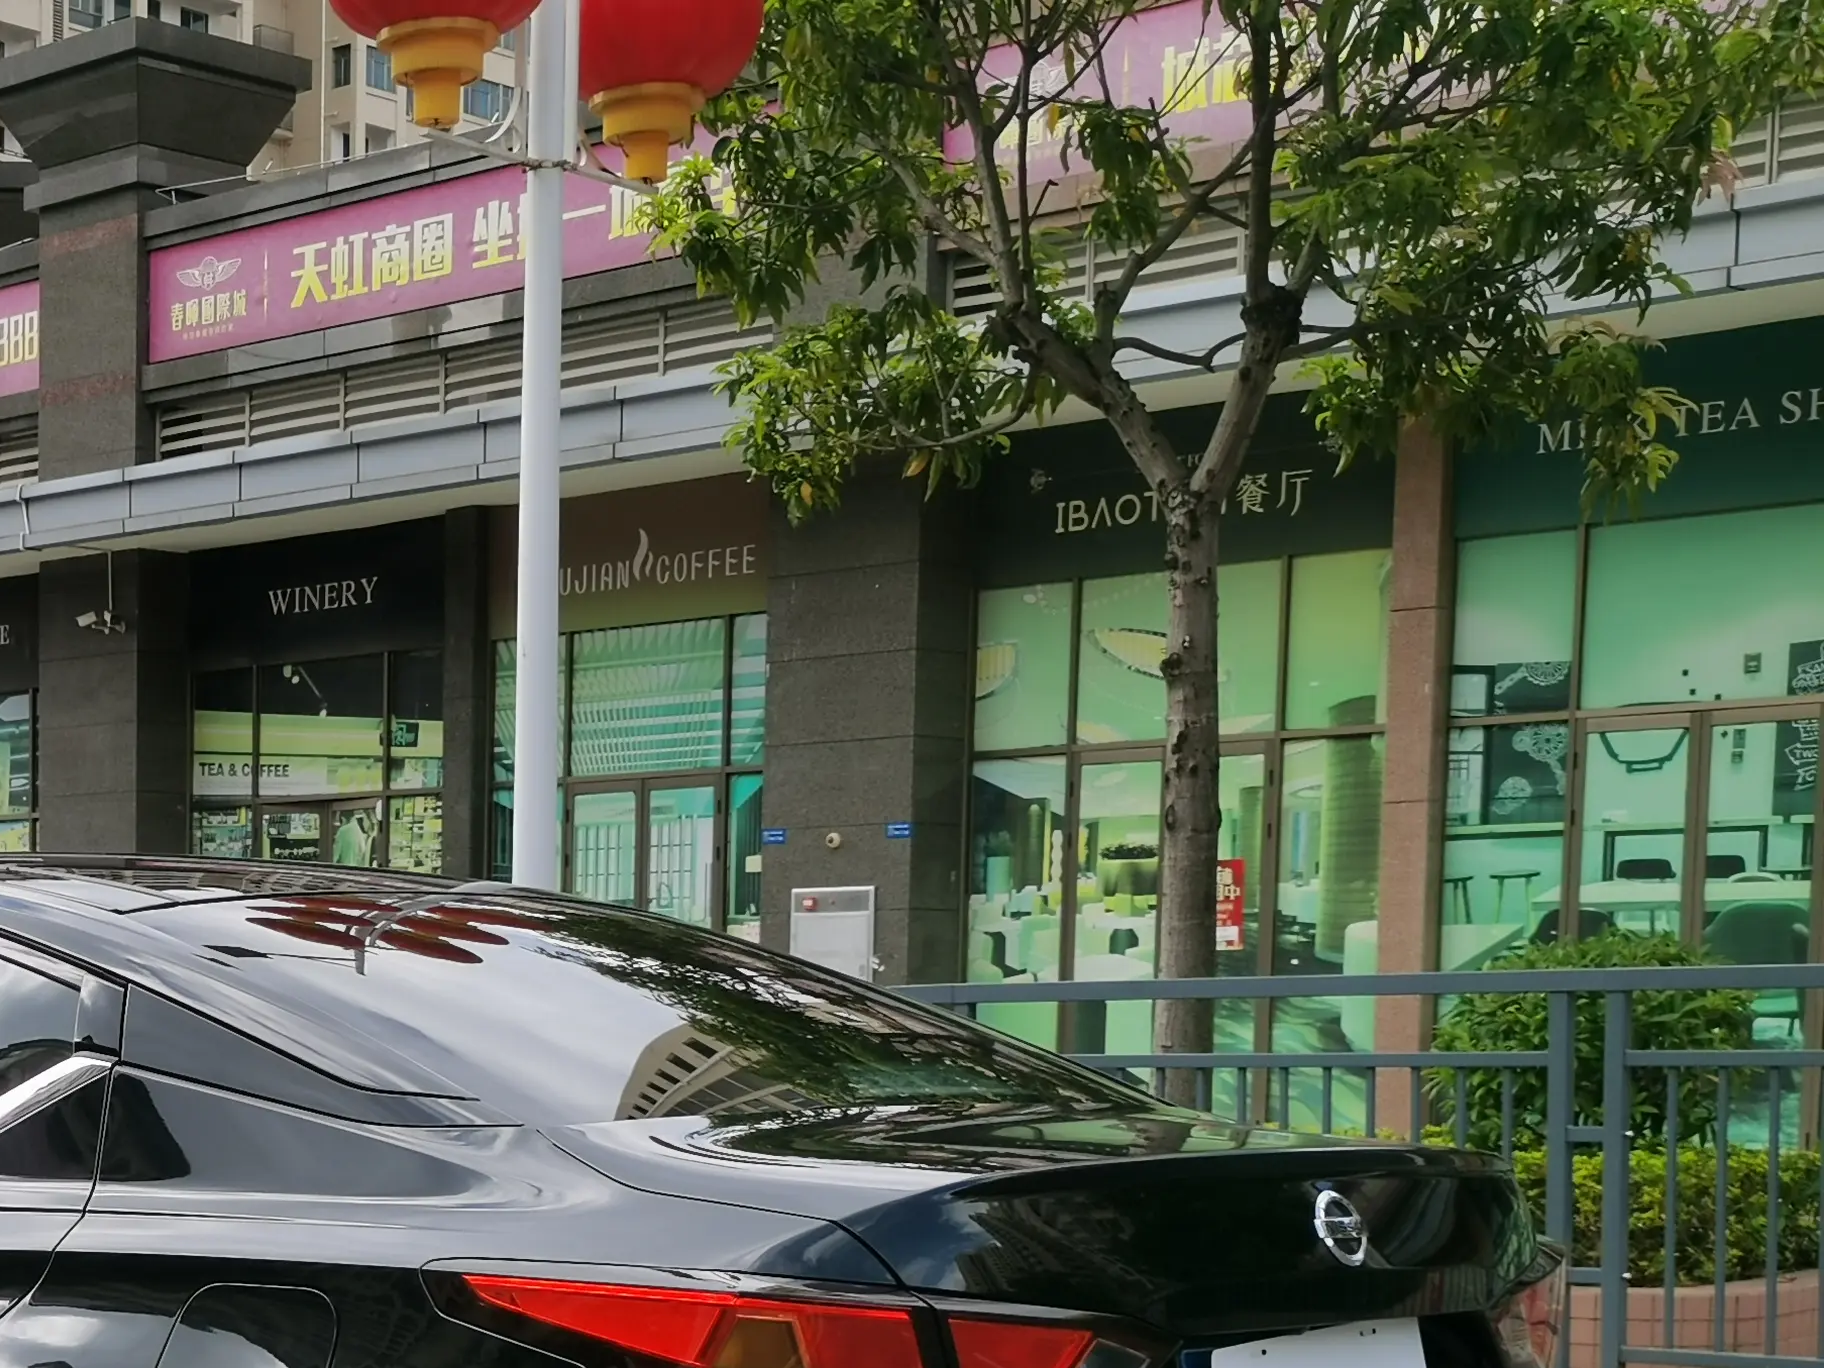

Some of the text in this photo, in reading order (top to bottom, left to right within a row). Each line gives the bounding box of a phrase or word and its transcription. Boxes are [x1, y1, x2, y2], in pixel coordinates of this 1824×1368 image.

[290, 213, 453, 308] 天虹商圈
[1536, 410, 1653, 455] MK
[1672, 397, 1761, 438] TEA
[1236, 469, 1313, 516] 餐厅
[656, 544, 756, 584] COFFEE
[268, 576, 378, 615] WINERY
[199, 762, 289, 778] TEA & CFFEE
